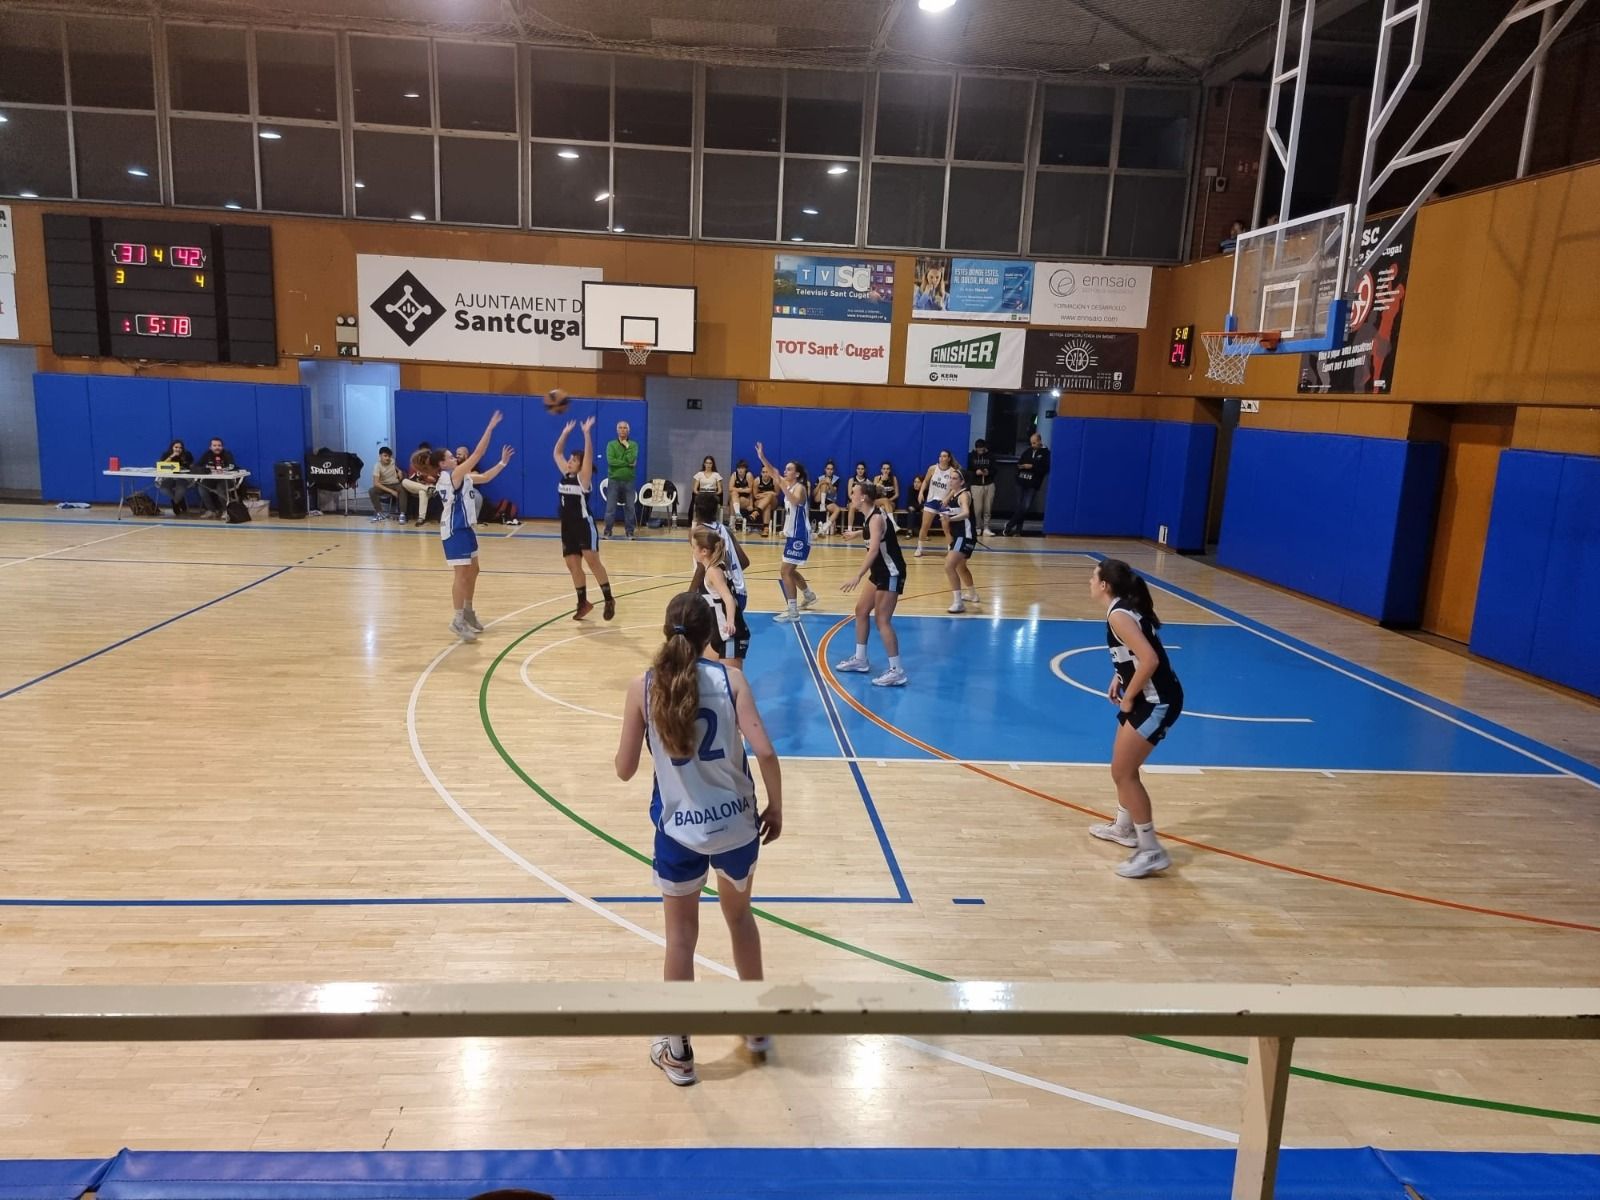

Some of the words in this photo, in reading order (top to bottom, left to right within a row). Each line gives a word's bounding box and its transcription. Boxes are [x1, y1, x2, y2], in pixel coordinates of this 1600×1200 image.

[122, 246, 144, 263] 31
[154, 249, 163, 262] 4
[178, 249, 200, 266] 42
[115, 270, 125, 284] 3
[195, 275, 205, 287] 4
[1082, 275, 1137, 288] ennsaio
[455, 292, 567, 312] AJUNTAMENT
[572, 299, 583, 313] D
[796, 288, 829, 297] Televisió
[830, 290, 847, 298] Sant
[848, 291, 870, 300] Cugat
[150, 317, 189, 335] 5:18
[454, 310, 580, 341] SantCuga
[775, 340, 807, 355] TOT
[807, 342, 839, 356] Sant
[845, 343, 885, 360] Cugat
[932, 340, 993, 362] FINISHER
[1172, 343, 1185, 362] 24
[311, 465, 344, 475] SPALDING
[674, 796, 750, 826] BADALONA
